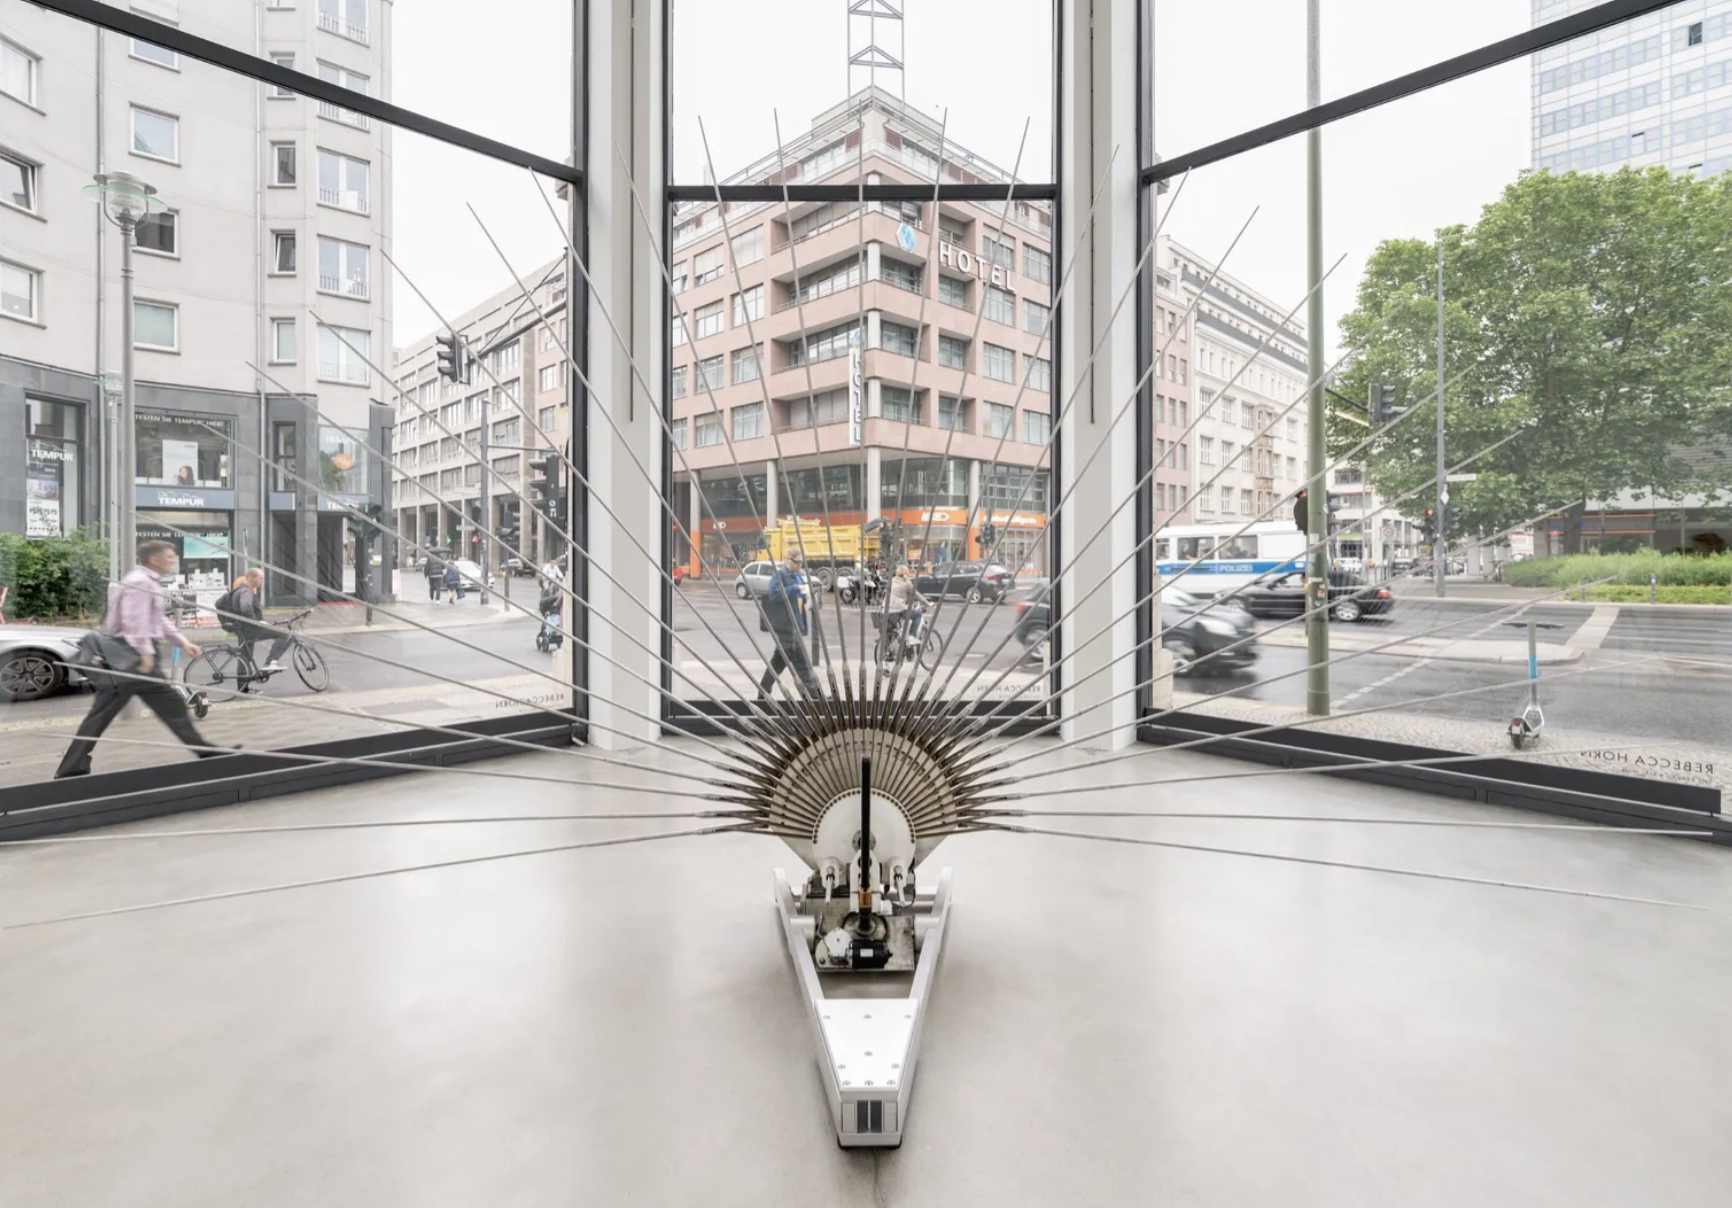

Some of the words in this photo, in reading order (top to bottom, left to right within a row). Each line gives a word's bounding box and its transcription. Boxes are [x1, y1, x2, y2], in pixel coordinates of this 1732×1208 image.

[939, 241, 1016, 293] HOTEL
[135, 413, 160, 422] TESTEN
[30, 449, 74, 462] TEMPUR
[158, 497, 205, 506] TEMPUR
